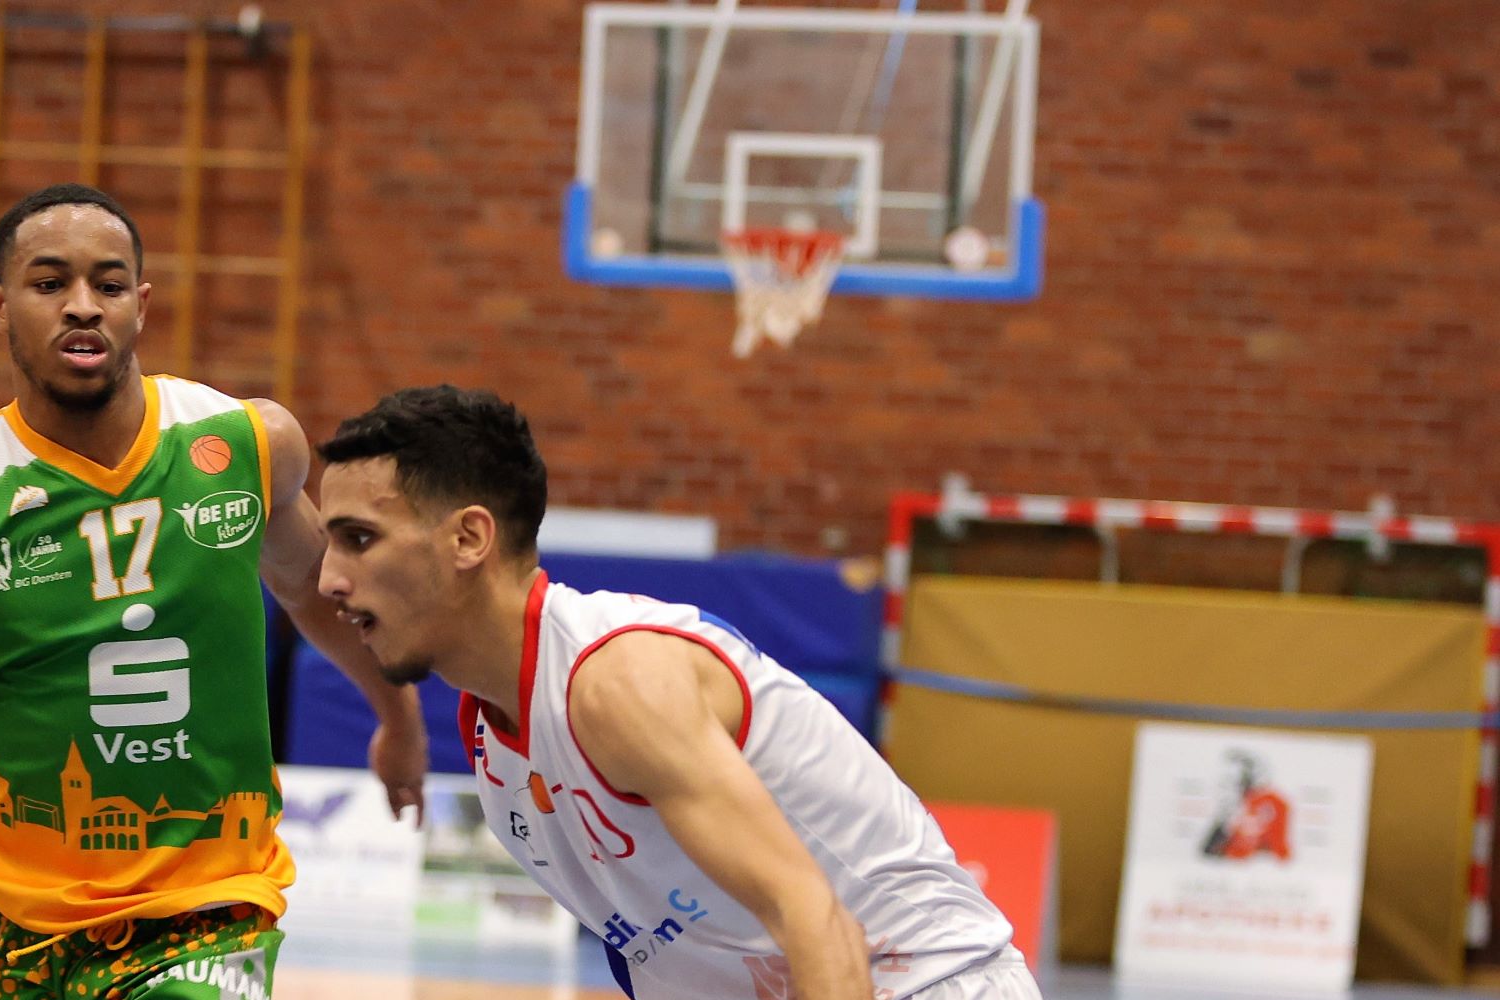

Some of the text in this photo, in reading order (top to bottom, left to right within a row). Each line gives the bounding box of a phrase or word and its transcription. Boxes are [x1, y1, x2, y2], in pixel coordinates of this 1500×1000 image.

[198, 497, 251, 525] BE FIT
[78, 497, 162, 600] 17
[14, 570, 73, 589] BG Dorsten
[92, 728, 193, 765] Vest
